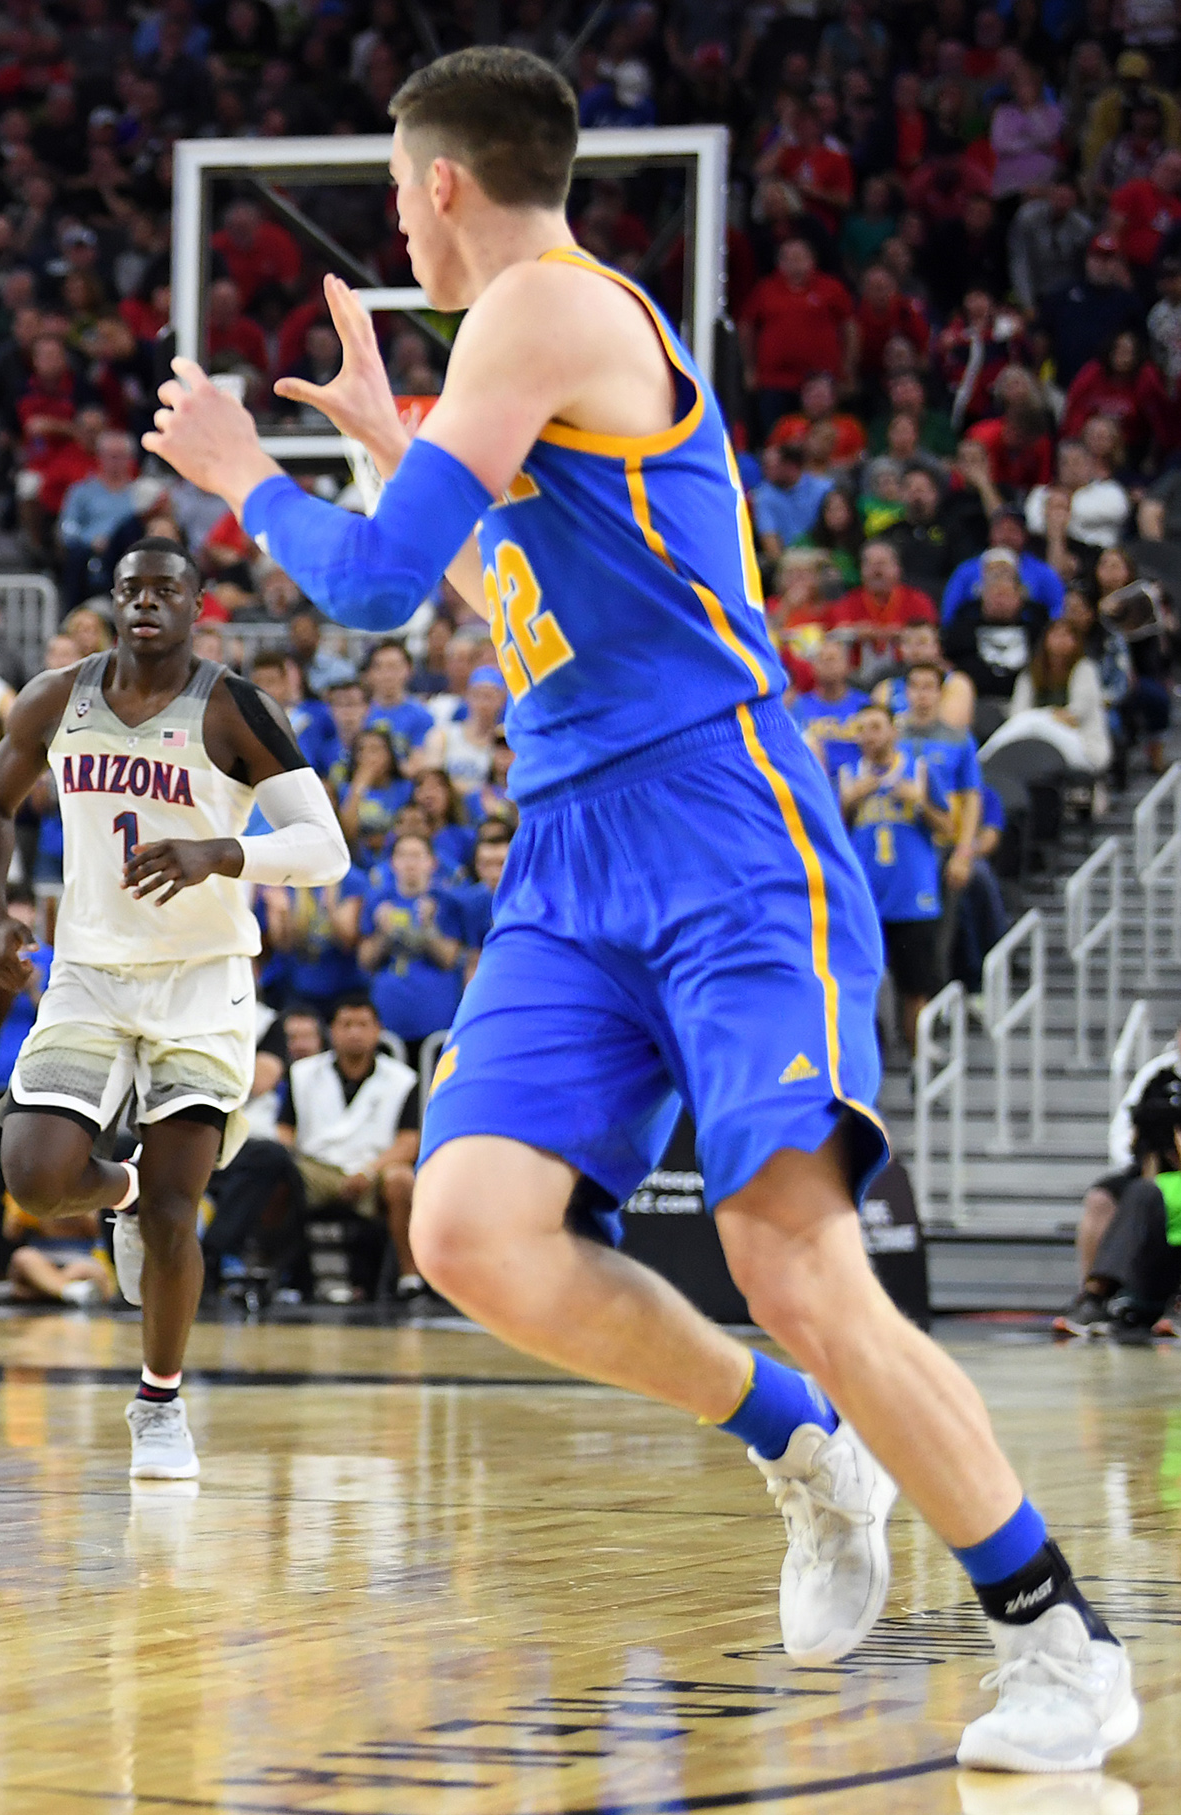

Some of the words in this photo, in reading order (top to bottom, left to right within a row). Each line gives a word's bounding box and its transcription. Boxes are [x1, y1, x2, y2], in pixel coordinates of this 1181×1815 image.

[483, 539, 575, 706] 22
[63, 753, 195, 807] ARIZONA
[112, 811, 139, 869] 1
